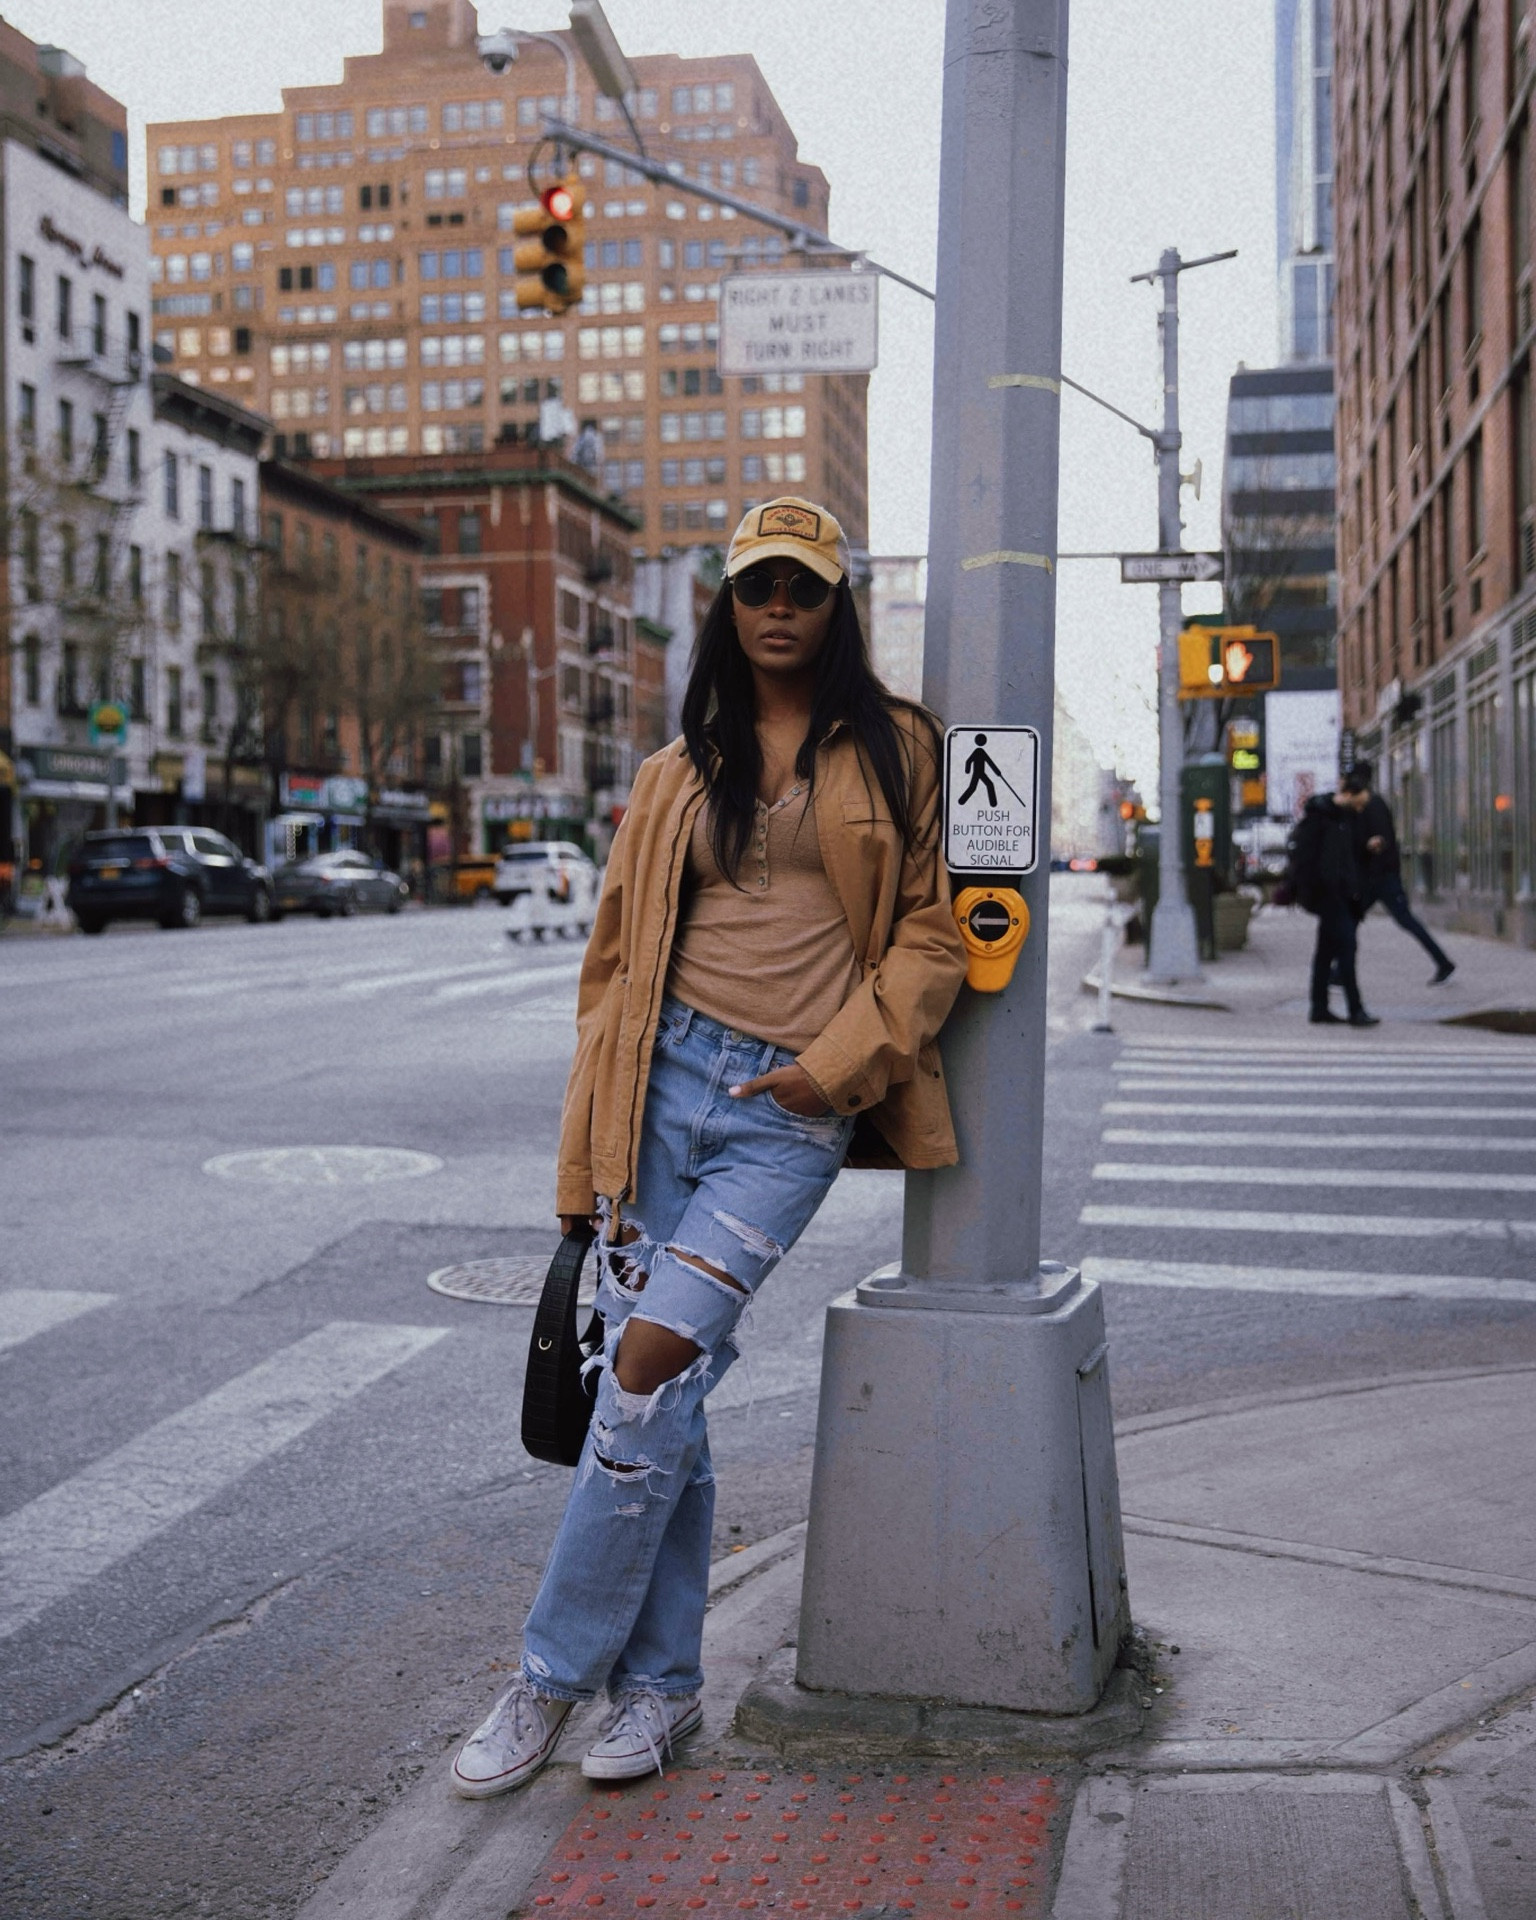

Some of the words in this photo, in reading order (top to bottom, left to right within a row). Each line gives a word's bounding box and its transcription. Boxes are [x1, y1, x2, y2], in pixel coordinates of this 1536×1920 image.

[729, 288, 780, 307] RIGHT
[789, 287, 801, 306] 2
[809, 284, 869, 304] LANES
[769, 314, 826, 332] MUST
[745, 342, 790, 361] TURN
[801, 340, 853, 360] RIGHT
[976, 810, 1010, 822] PUSH
[953, 824, 1003, 836] BUTTON
[1006, 825, 1030, 837] FOR
[966, 839, 1019, 852] AUDIBLE
[970, 854, 1014, 866] SIGNAL
